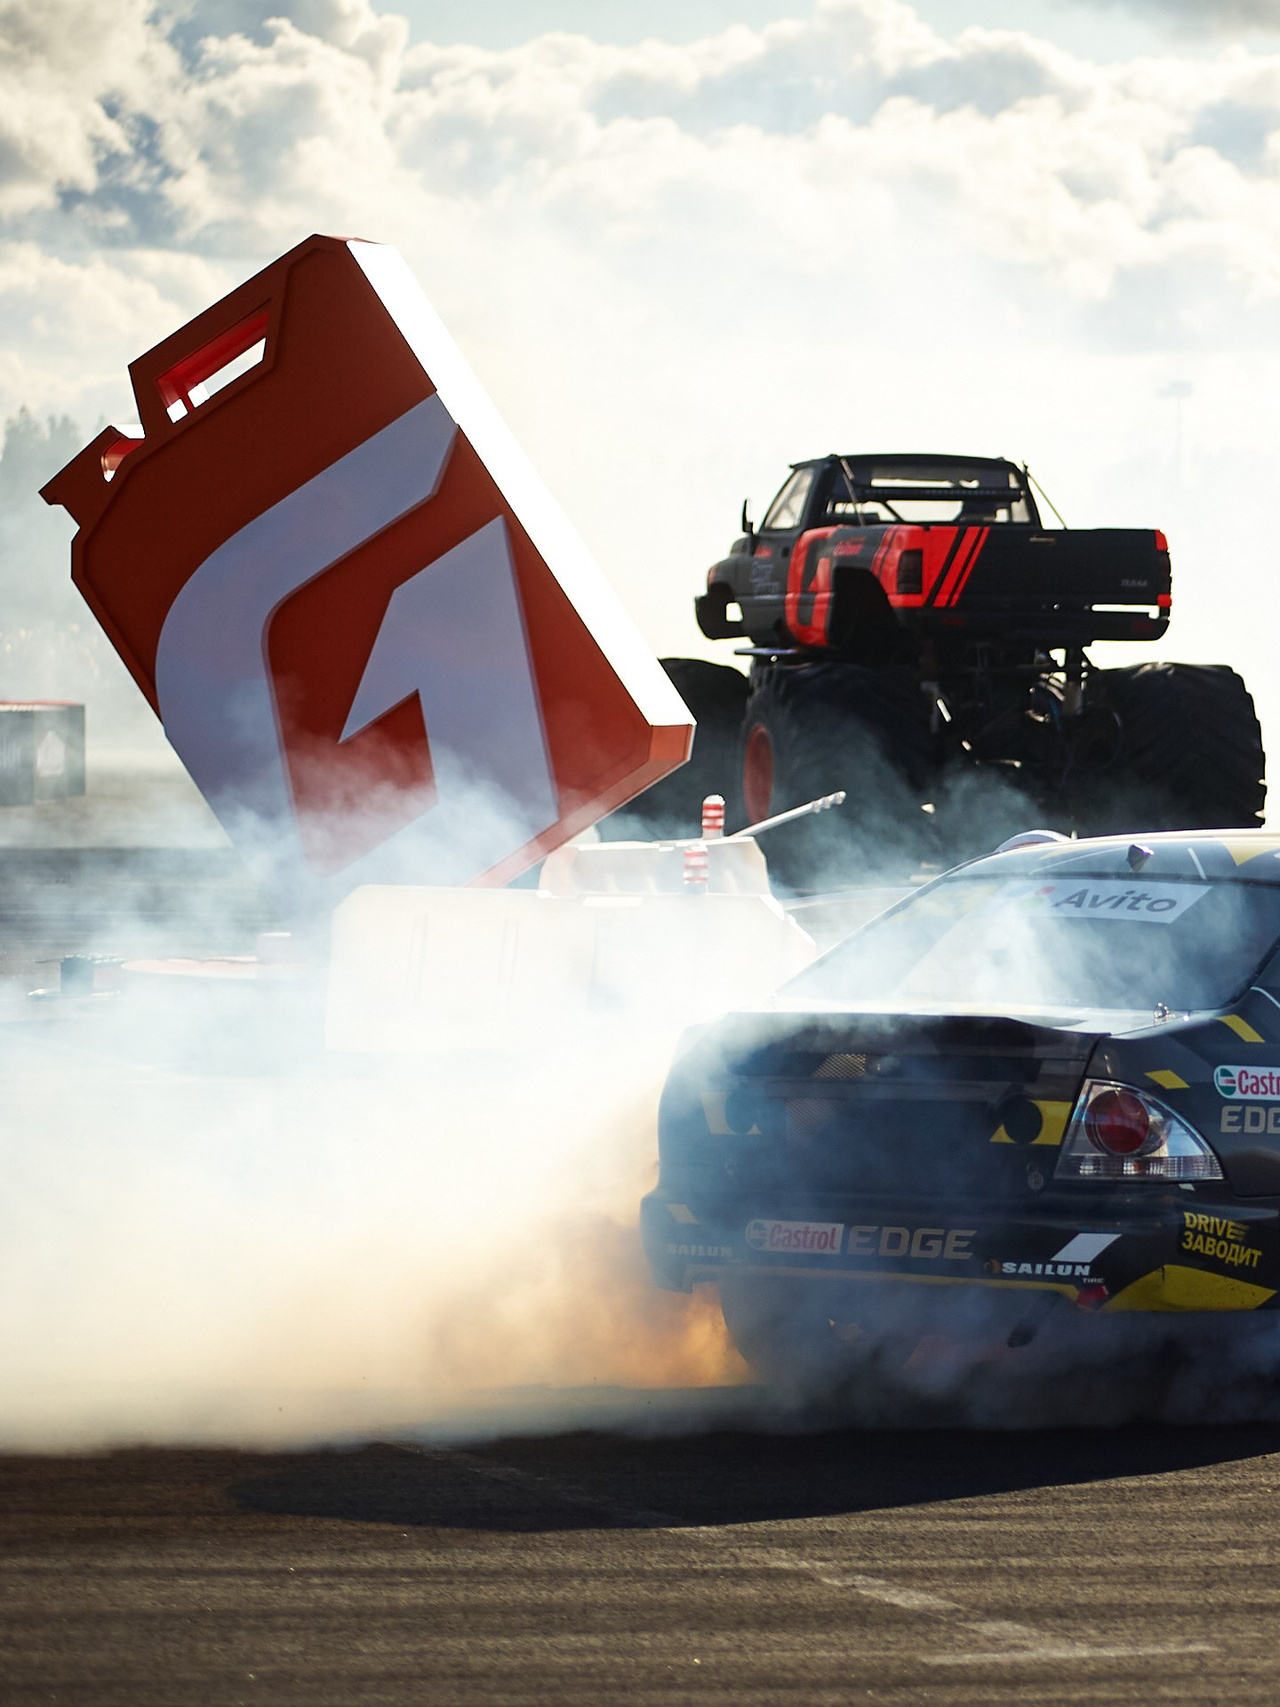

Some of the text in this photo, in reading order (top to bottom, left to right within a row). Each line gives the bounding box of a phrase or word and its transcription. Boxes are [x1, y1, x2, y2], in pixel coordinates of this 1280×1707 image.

[1052, 888, 1177, 912] Avito
[1183, 1211, 1244, 1240] DRIVE
[769, 1224, 977, 1260] Castrol EDGE
[1182, 1231, 1262, 1268] ЗАВОДИТ
[1001, 1262, 1090, 1276] SAILUN
